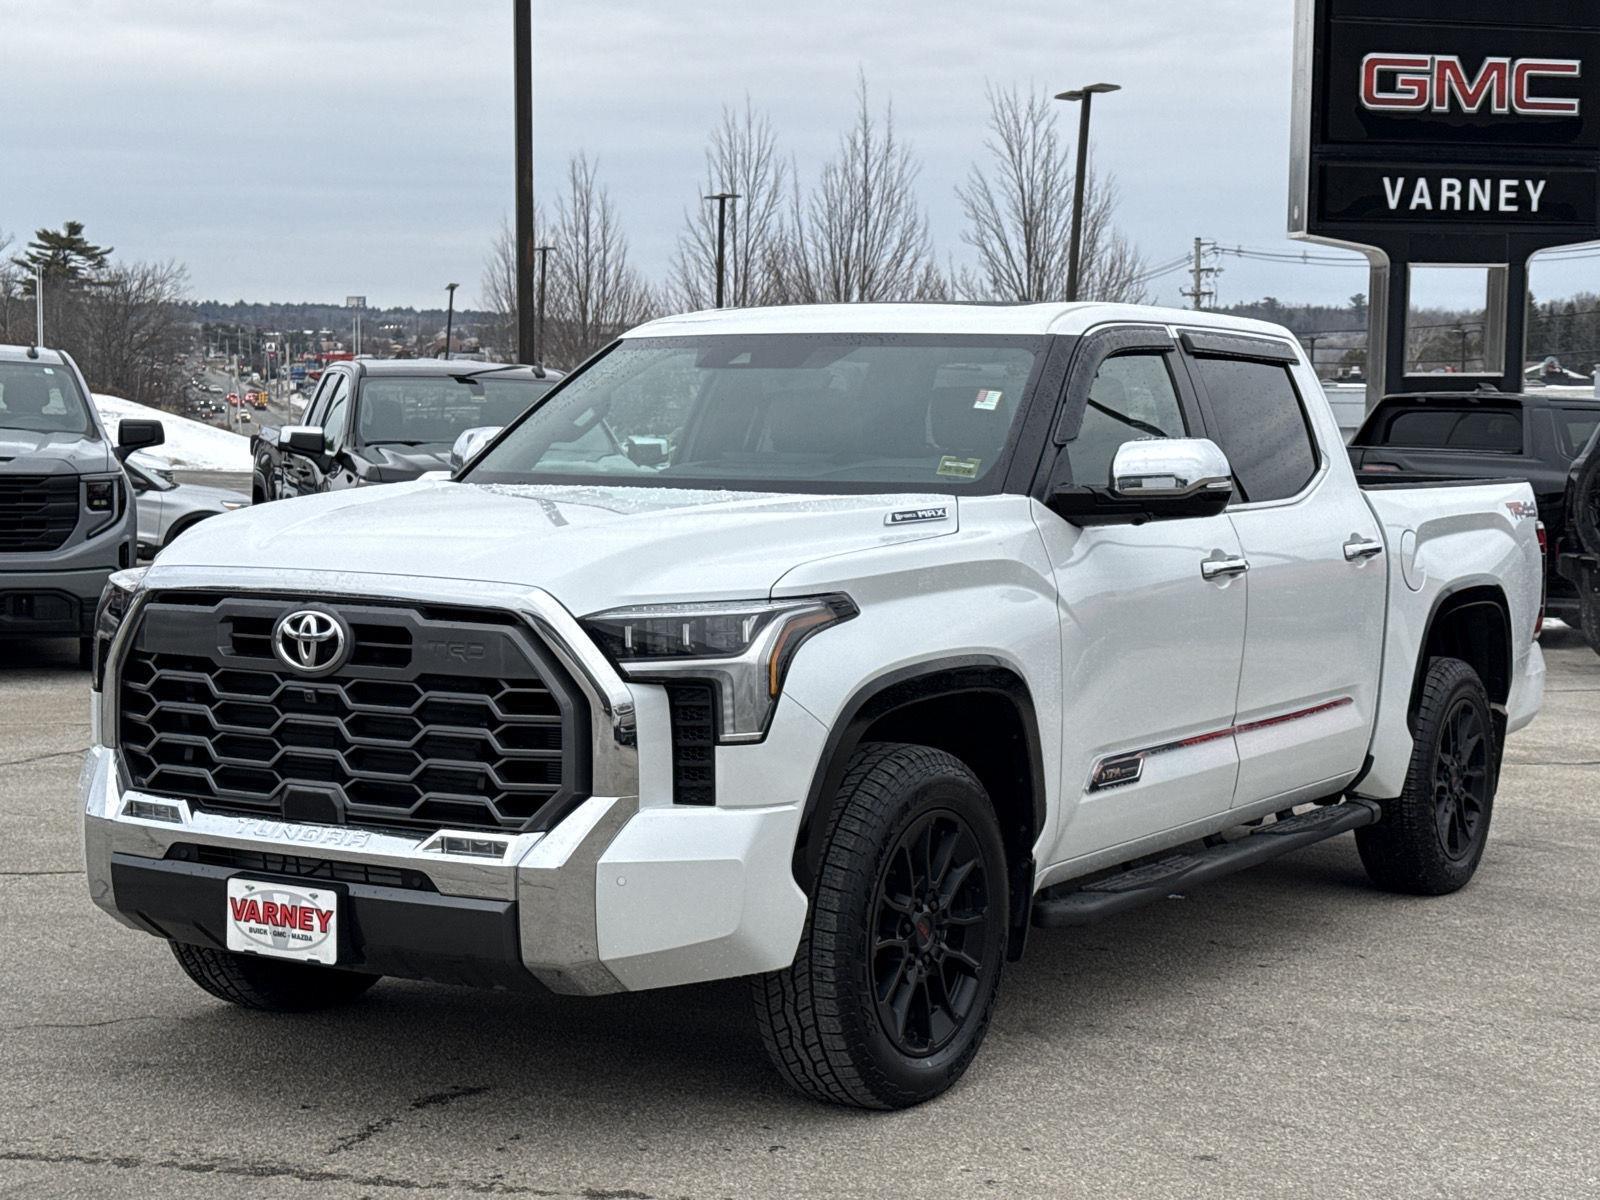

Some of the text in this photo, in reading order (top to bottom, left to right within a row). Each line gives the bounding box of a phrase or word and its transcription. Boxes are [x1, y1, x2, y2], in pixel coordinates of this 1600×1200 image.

[1360, 52, 1581, 116] GMC
[1382, 176, 1546, 212] VARNEY
[426, 640, 486, 662] TRD
[236, 819, 371, 847] TUNDRA
[229, 896, 334, 933] VARNEY
[248, 926, 313, 942] BUICK GMC MAZDA
